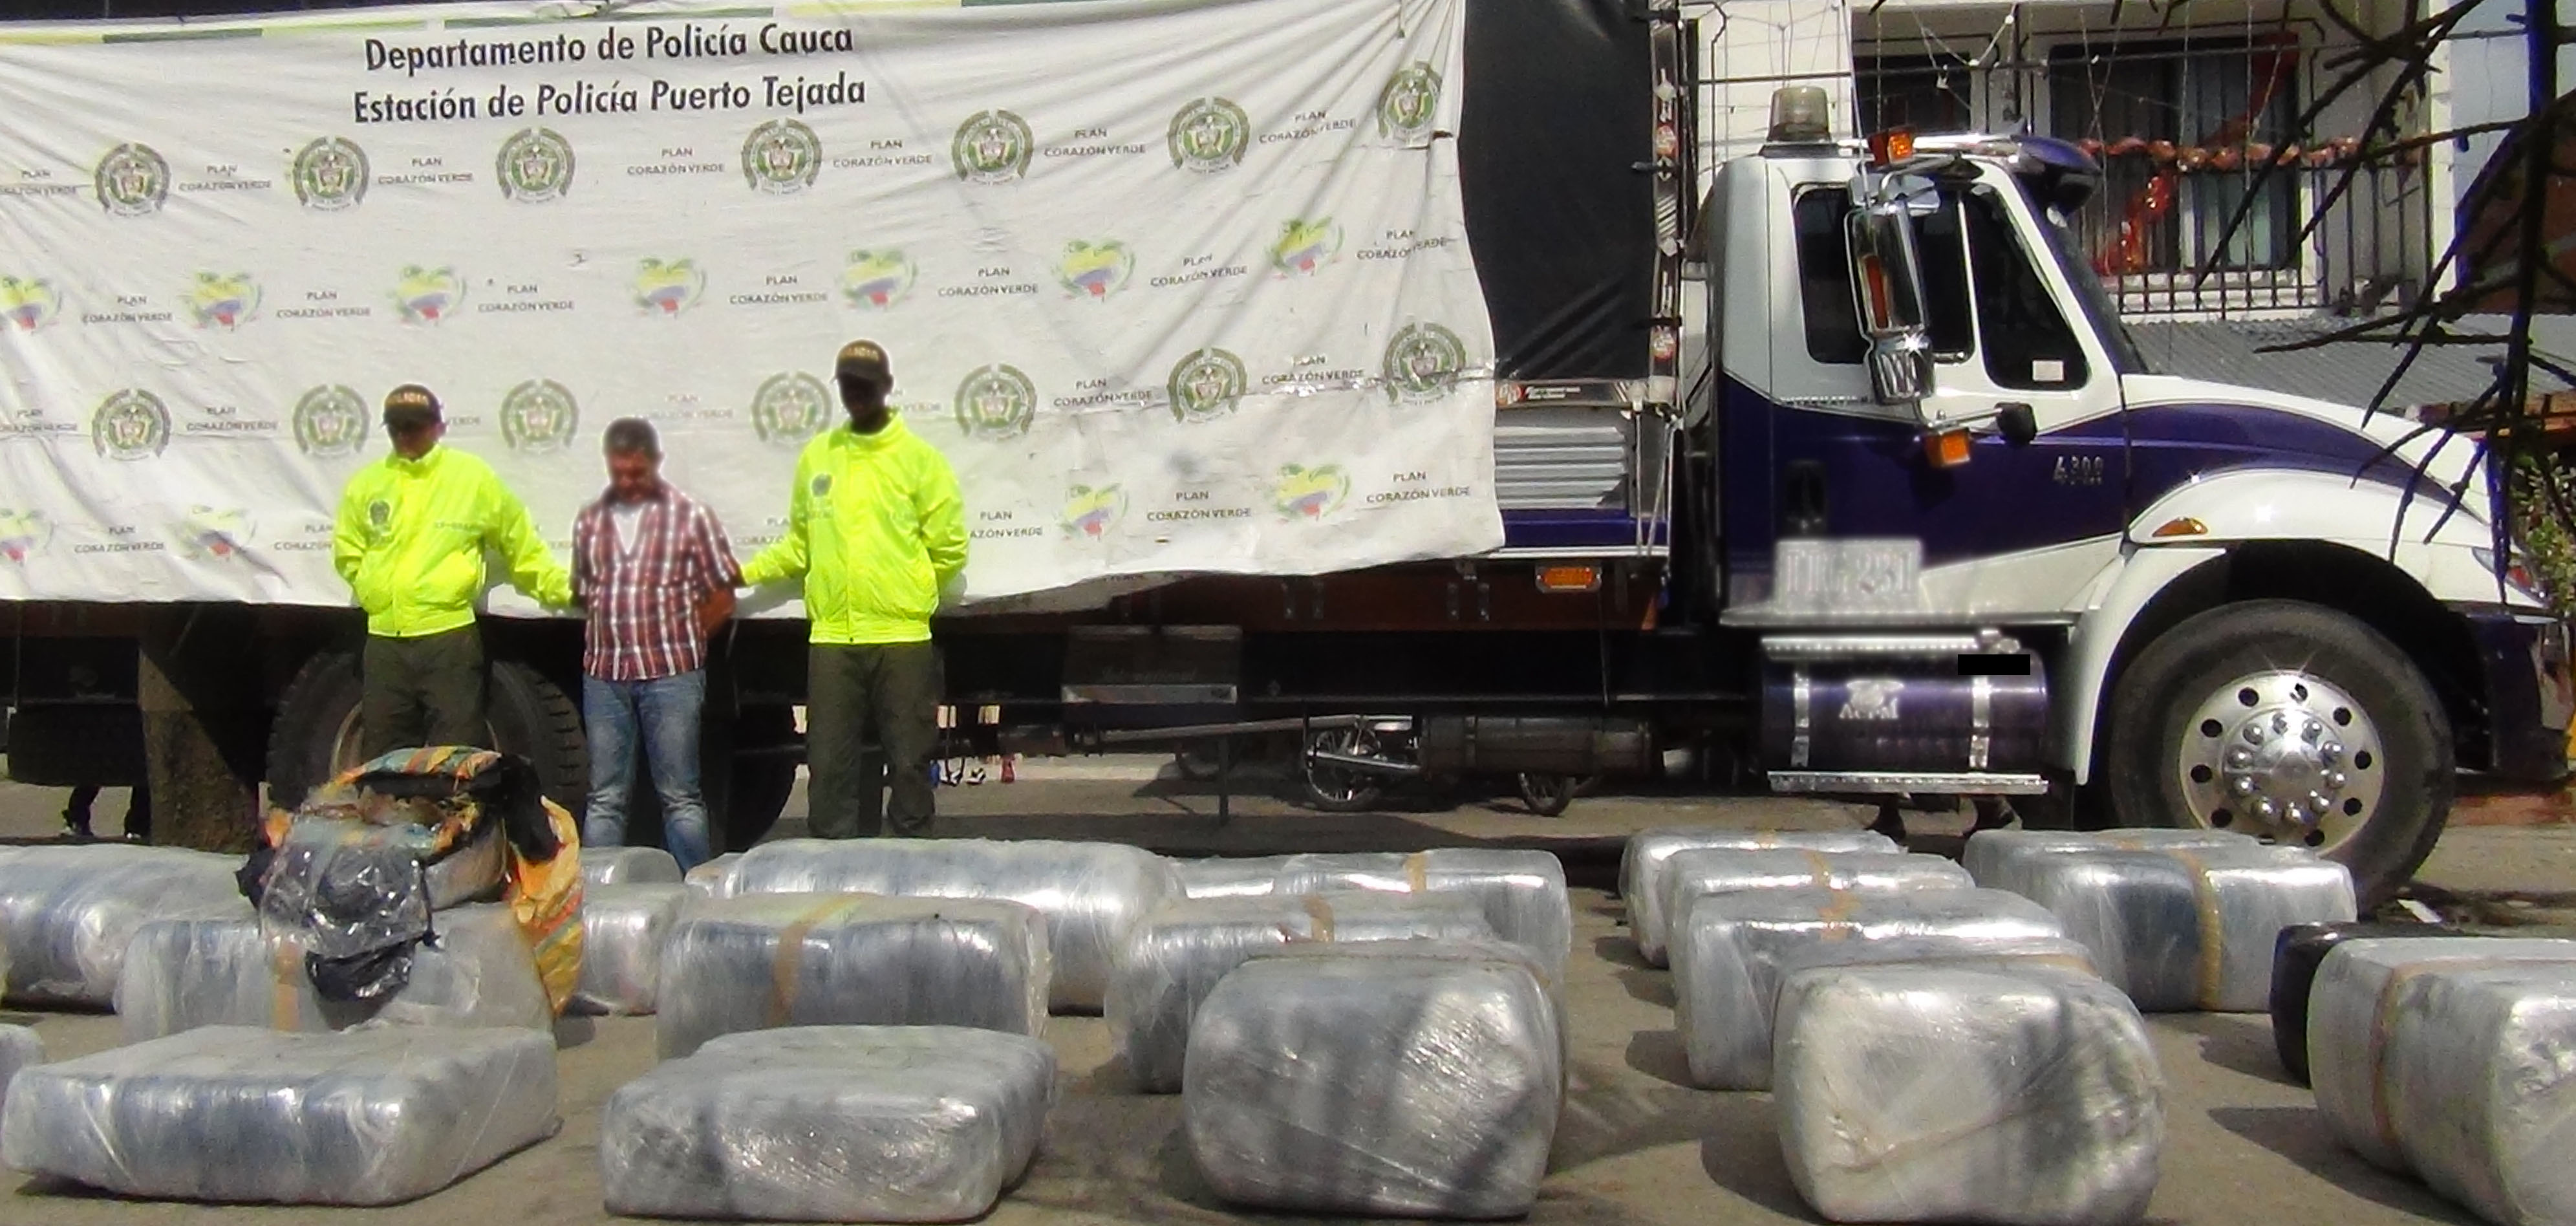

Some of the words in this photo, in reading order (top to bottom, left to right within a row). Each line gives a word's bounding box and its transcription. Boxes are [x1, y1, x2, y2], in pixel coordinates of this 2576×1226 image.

[365, 34, 586, 76] Departamento
[598, 27, 634, 61] de
[646, 23, 747, 58] Policía
[758, 23, 853, 54] Cauca
[354, 87, 476, 123] Estación
[488, 85, 525, 117] de
[537, 80, 638, 115] Policía
[650, 79, 751, 111] Puerto
[762, 71, 866, 113] Tejada
[1295, 111, 1327, 123] PLAN
[1075, 129, 1107, 138] PLAN
[870, 140, 903, 149] PLAN
[661, 148, 692, 157] PLAN
[412, 158, 442, 167] PLAN
[206, 166, 237, 175] PLAN
[1183, 253, 1213, 267] PLAN
[978, 267, 1011, 277] PLAN
[766, 275, 798, 285] PLAN
[507, 285, 538, 294] PLAN
[306, 291, 338, 300] PLAN
[117, 296, 147, 306] PLAN
[1293, 356, 1326, 367] LAN
[1076, 378, 1107, 390] PLAN
[1393, 472, 1426, 482] PLAN
[1175, 491, 1209, 501] PLAN
[980, 511, 1013, 521] PLAN
[766, 518, 790, 527] PLA
[970, 526, 1005, 539] AZÓN
